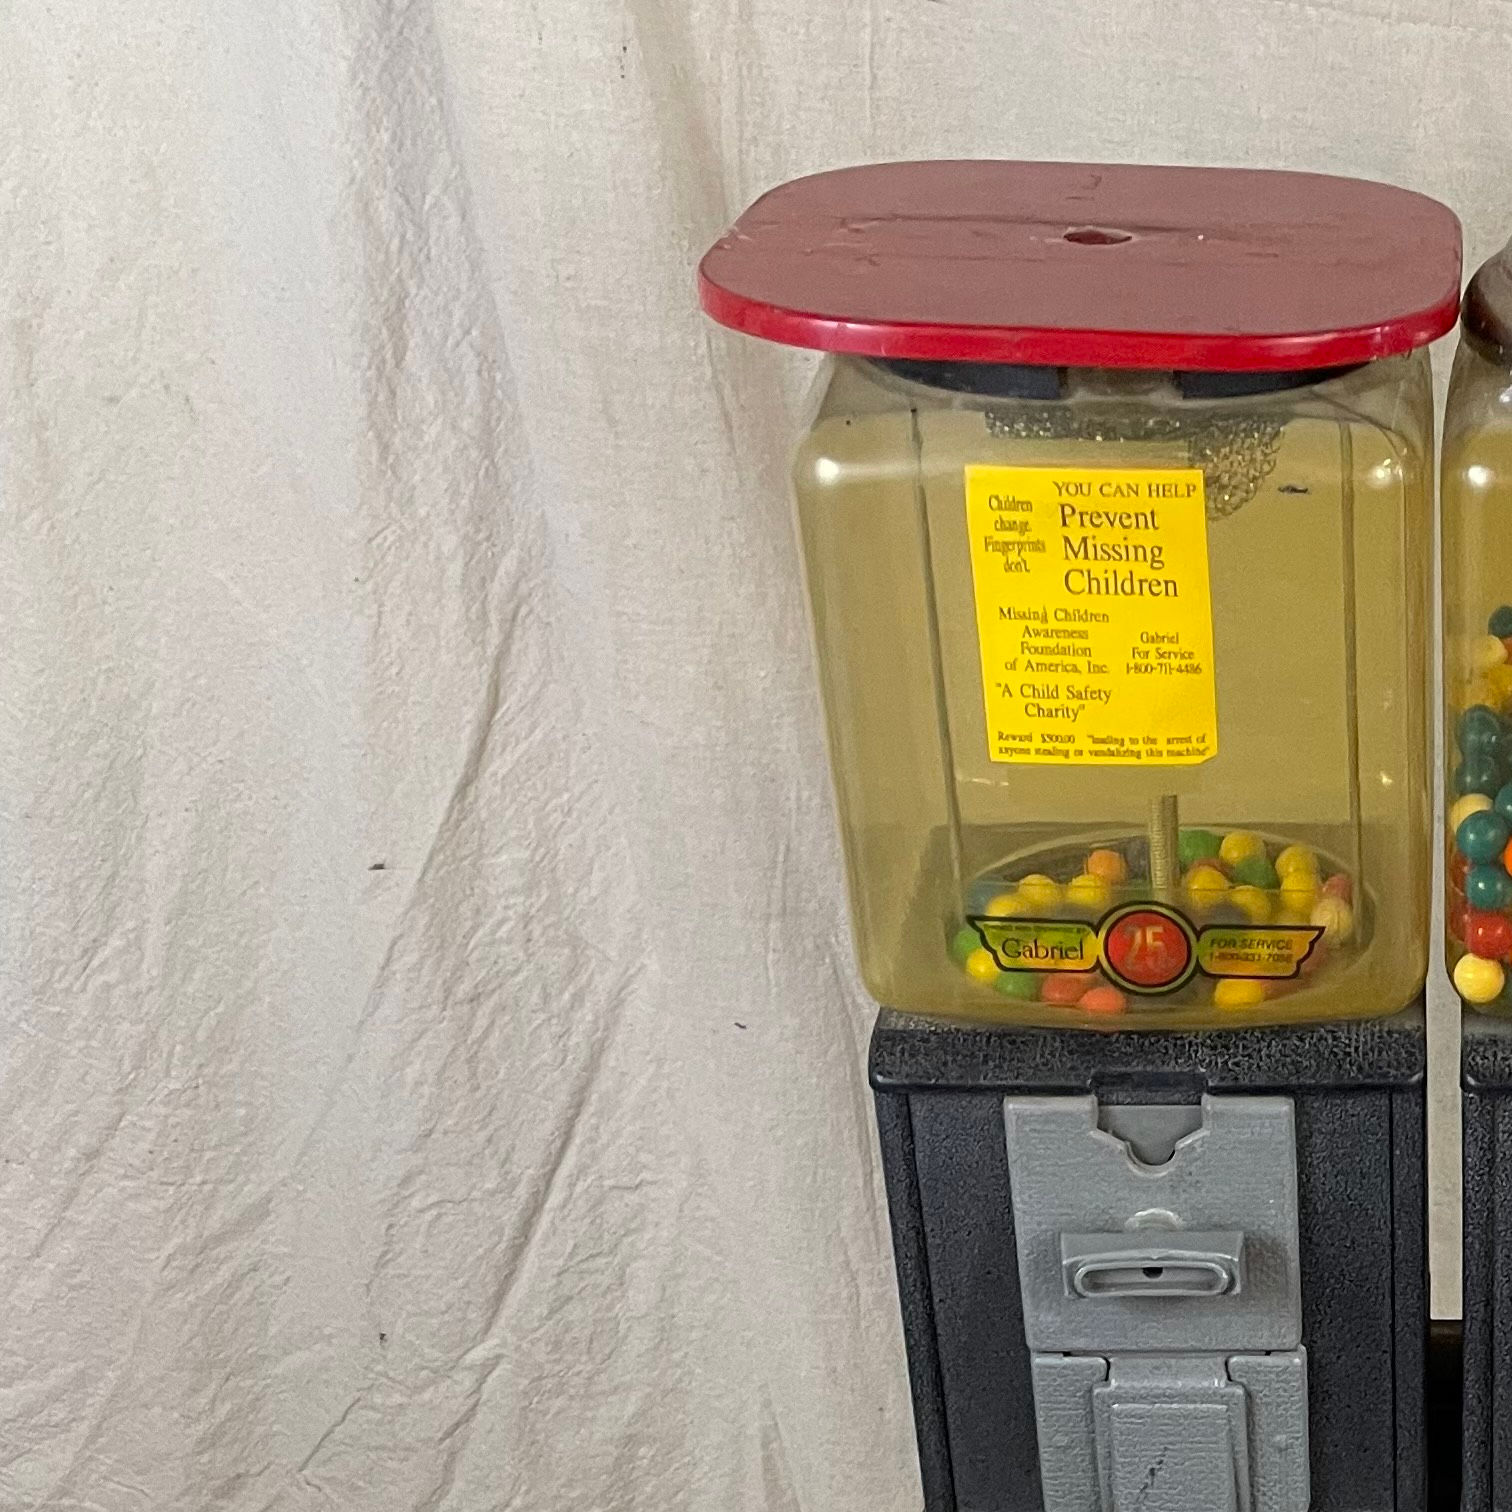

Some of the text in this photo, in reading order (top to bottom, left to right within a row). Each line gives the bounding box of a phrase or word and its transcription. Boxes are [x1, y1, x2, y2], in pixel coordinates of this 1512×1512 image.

[1052, 481, 1197, 499] YOU CAN HELP
[988, 494, 1033, 512] Children
[1059, 503, 1160, 531] Prevent
[1062, 535, 1165, 570] Missing
[1064, 568, 1179, 598] Children
[999, 606, 1110, 624] Missing Children
[1022, 625, 1089, 640] Awareness
[1140, 631, 1180, 644] Gabriel
[1020, 641, 1092, 657] Foundation
[1131, 646, 1195, 660] For Service
[1004, 658, 1018, 671] of
[1024, 659, 1082, 674] America,
[1020, 683, 1060, 699] Child
[1066, 684, 1112, 705] Safety
[1024, 702, 1086, 723] Charity"
[998, 731, 1033, 742] Reward
[1001, 937, 1084, 960] Gabriel
[1210, 938, 1294, 950] FOR SERVICE
